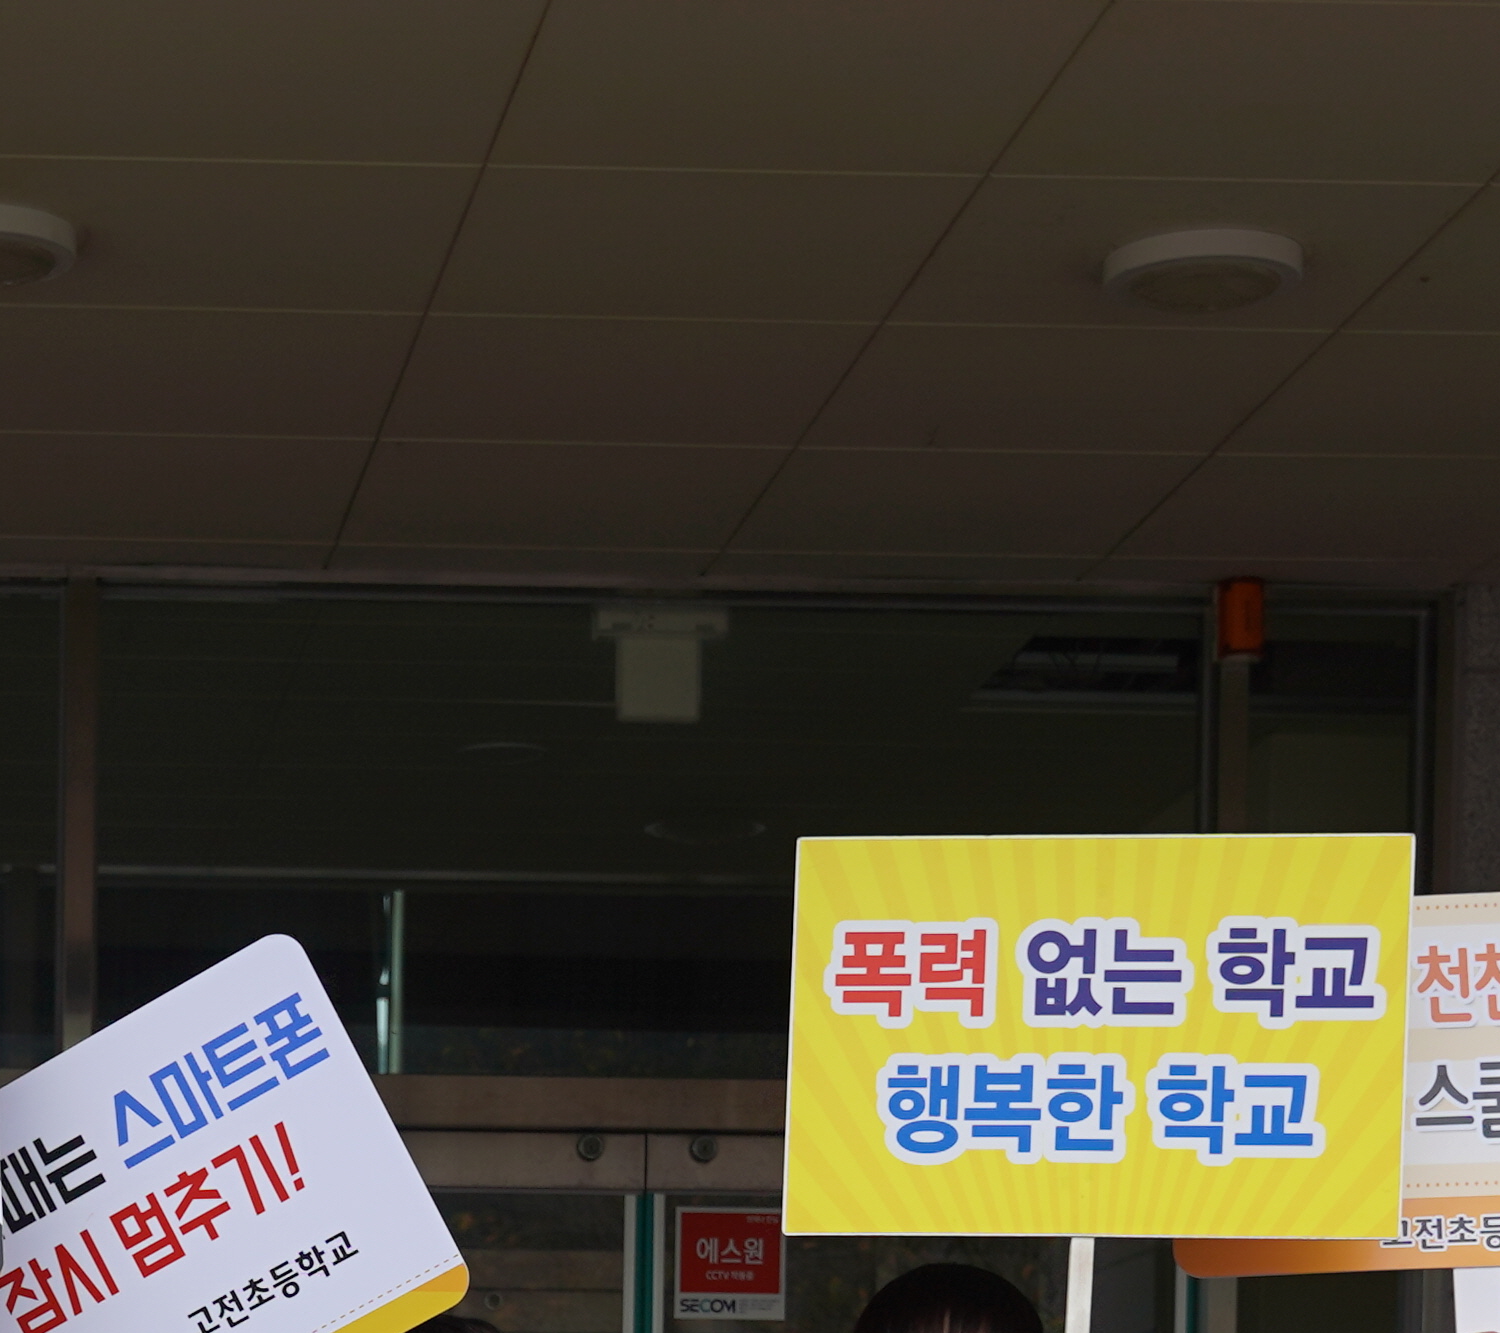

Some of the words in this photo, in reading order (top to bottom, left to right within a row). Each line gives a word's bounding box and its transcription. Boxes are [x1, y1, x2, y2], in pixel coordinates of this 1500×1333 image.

[834, 929, 988, 1019] 폭력
[1026, 928, 1183, 1017] 없는
[1217, 926, 1375, 1016] 학교
[0, 1134, 107, 1238] 때는
[112, 991, 331, 1170] 스마트폰
[887, 1062, 1125, 1155] 행복한
[1156, 1062, 1314, 1155] 학교
[108, 1120, 306, 1278] 멈추기!
[695, 1236, 765, 1265] 에스원
[705, 1270, 730, 1281] CCTV
[680, 1298, 736, 1314] SECOM
